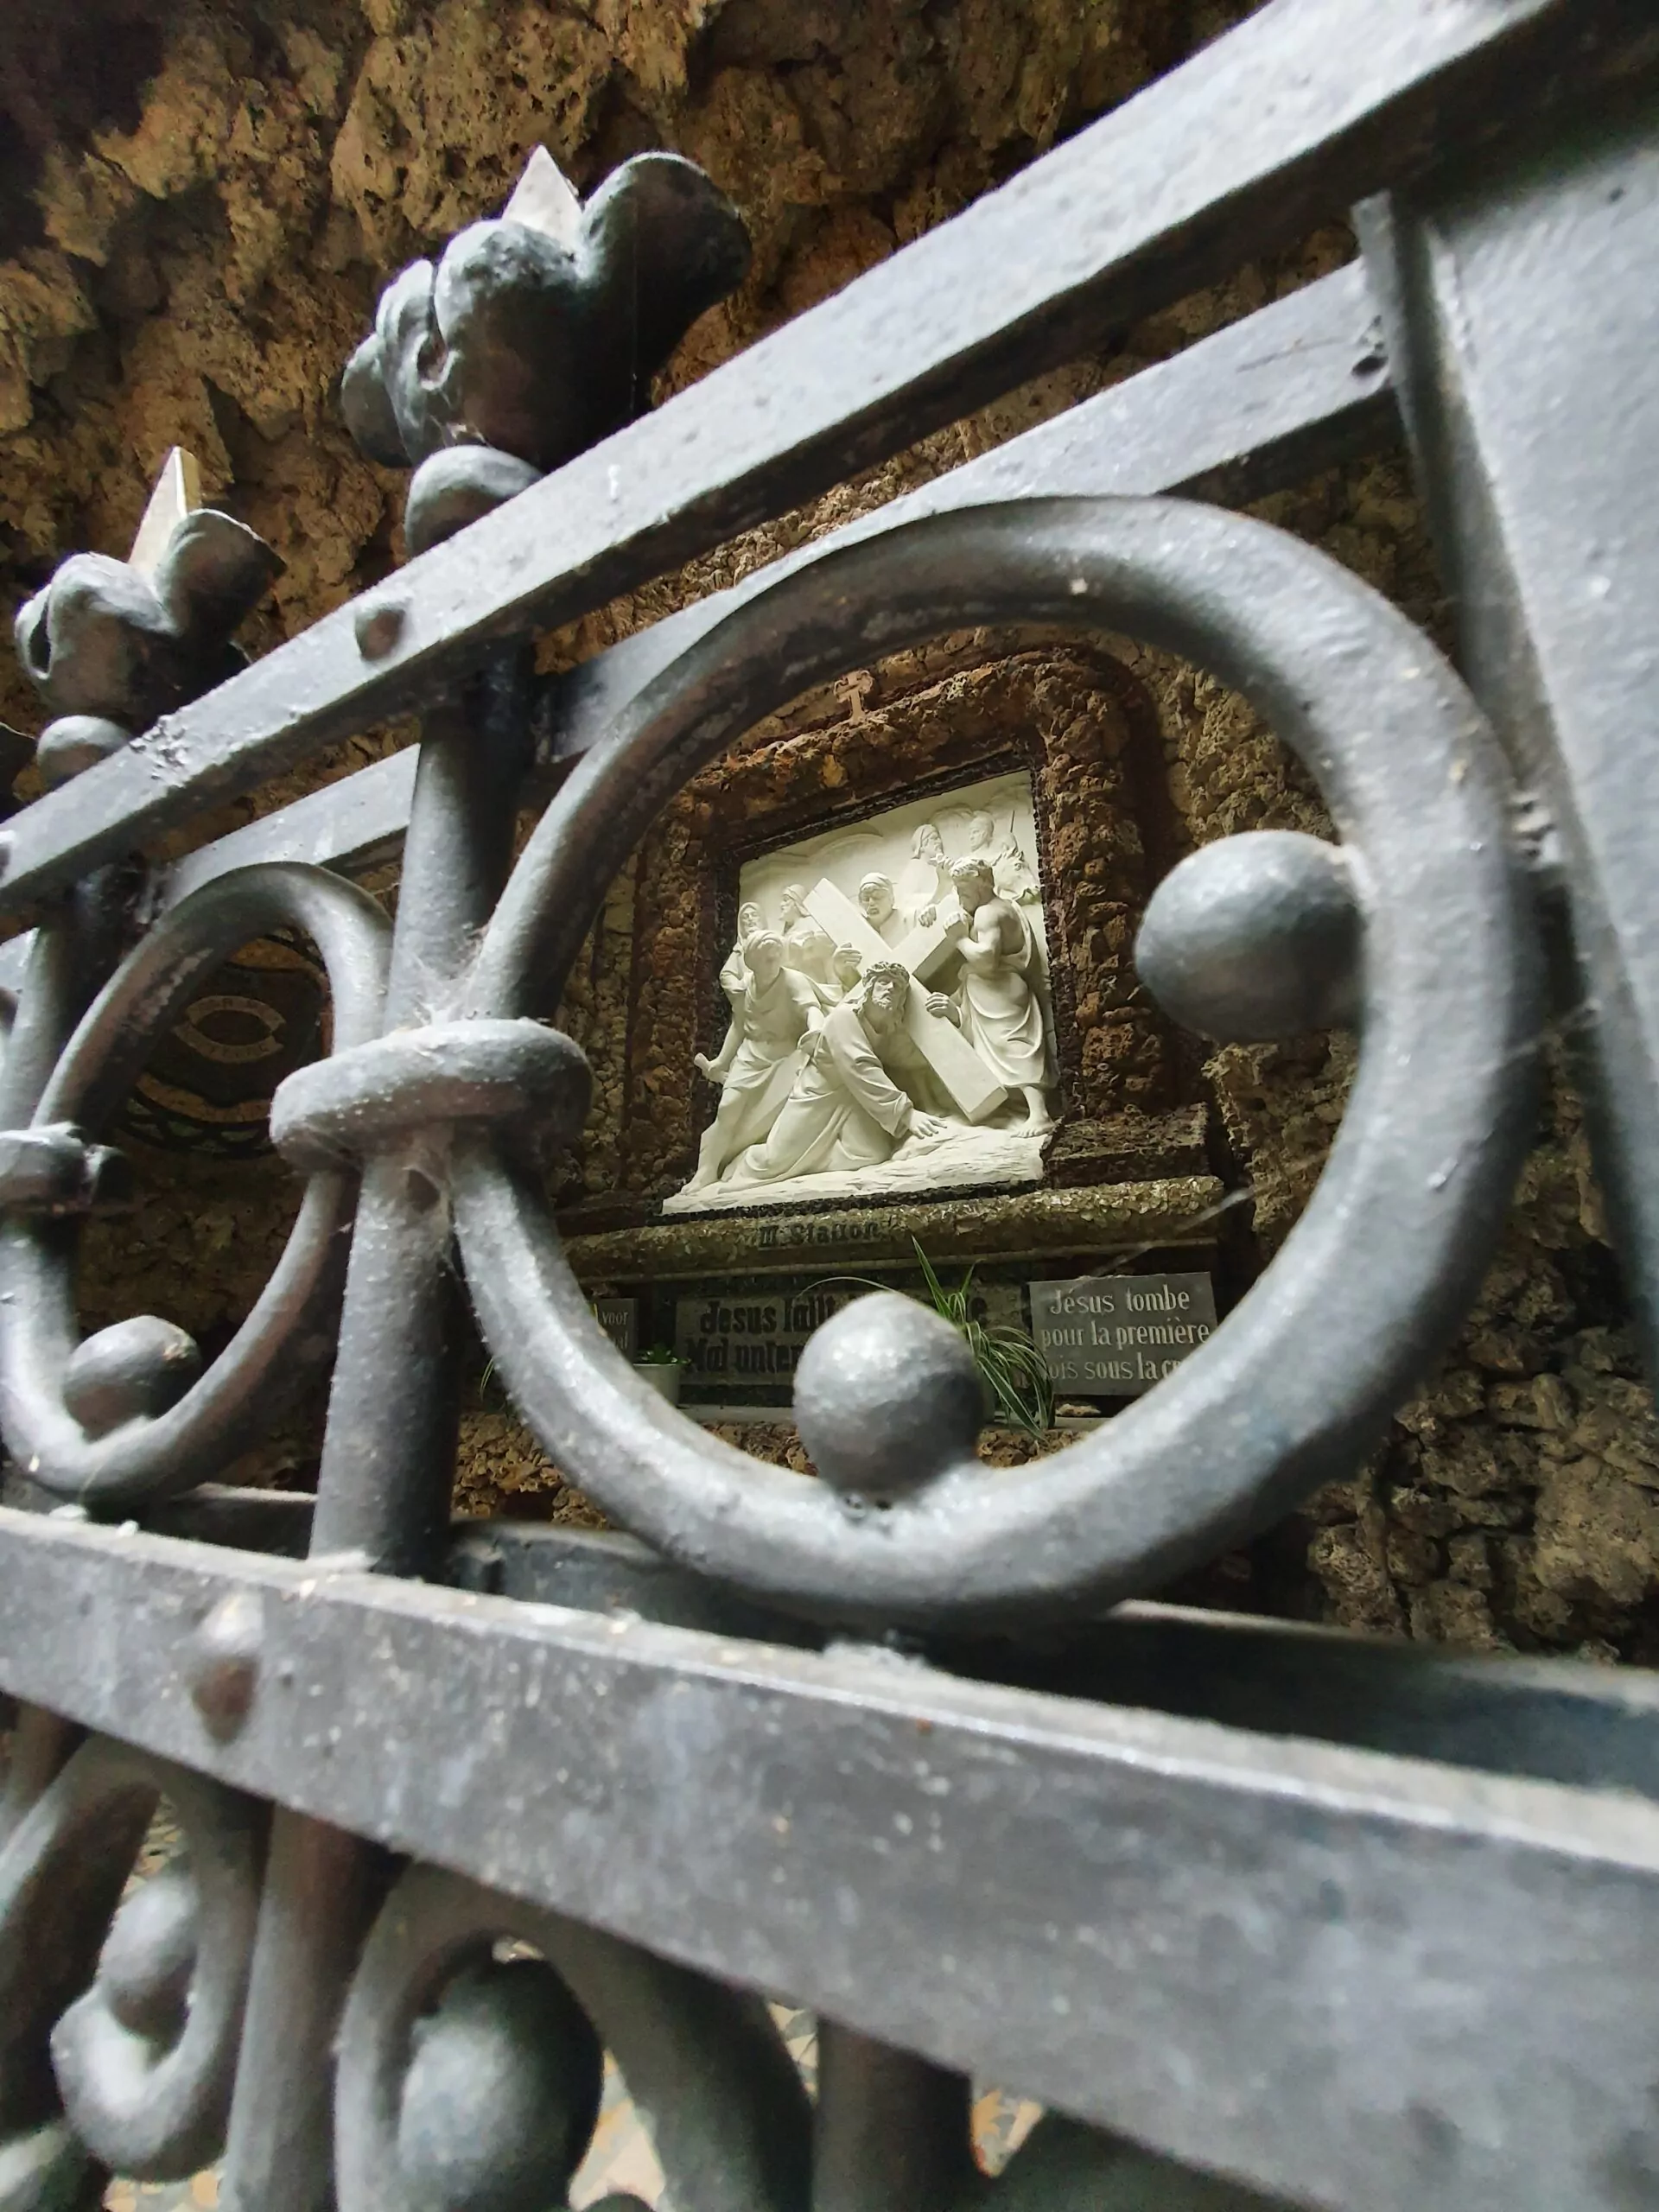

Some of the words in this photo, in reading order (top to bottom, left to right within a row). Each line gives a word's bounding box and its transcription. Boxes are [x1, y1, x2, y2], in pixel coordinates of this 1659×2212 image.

[1050, 1287, 1115, 1314] Jésus
[1126, 1284, 1190, 1312] tombe
[601, 1311, 629, 1325] voor
[699, 1300, 777, 1333] Jesus
[1042, 1326, 1084, 1351] pour
[1091, 1320, 1111, 1345] la
[1116, 1318, 1210, 1351] première
[1084, 1359, 1133, 1380] sous
[1137, 1352, 1157, 1380] la
